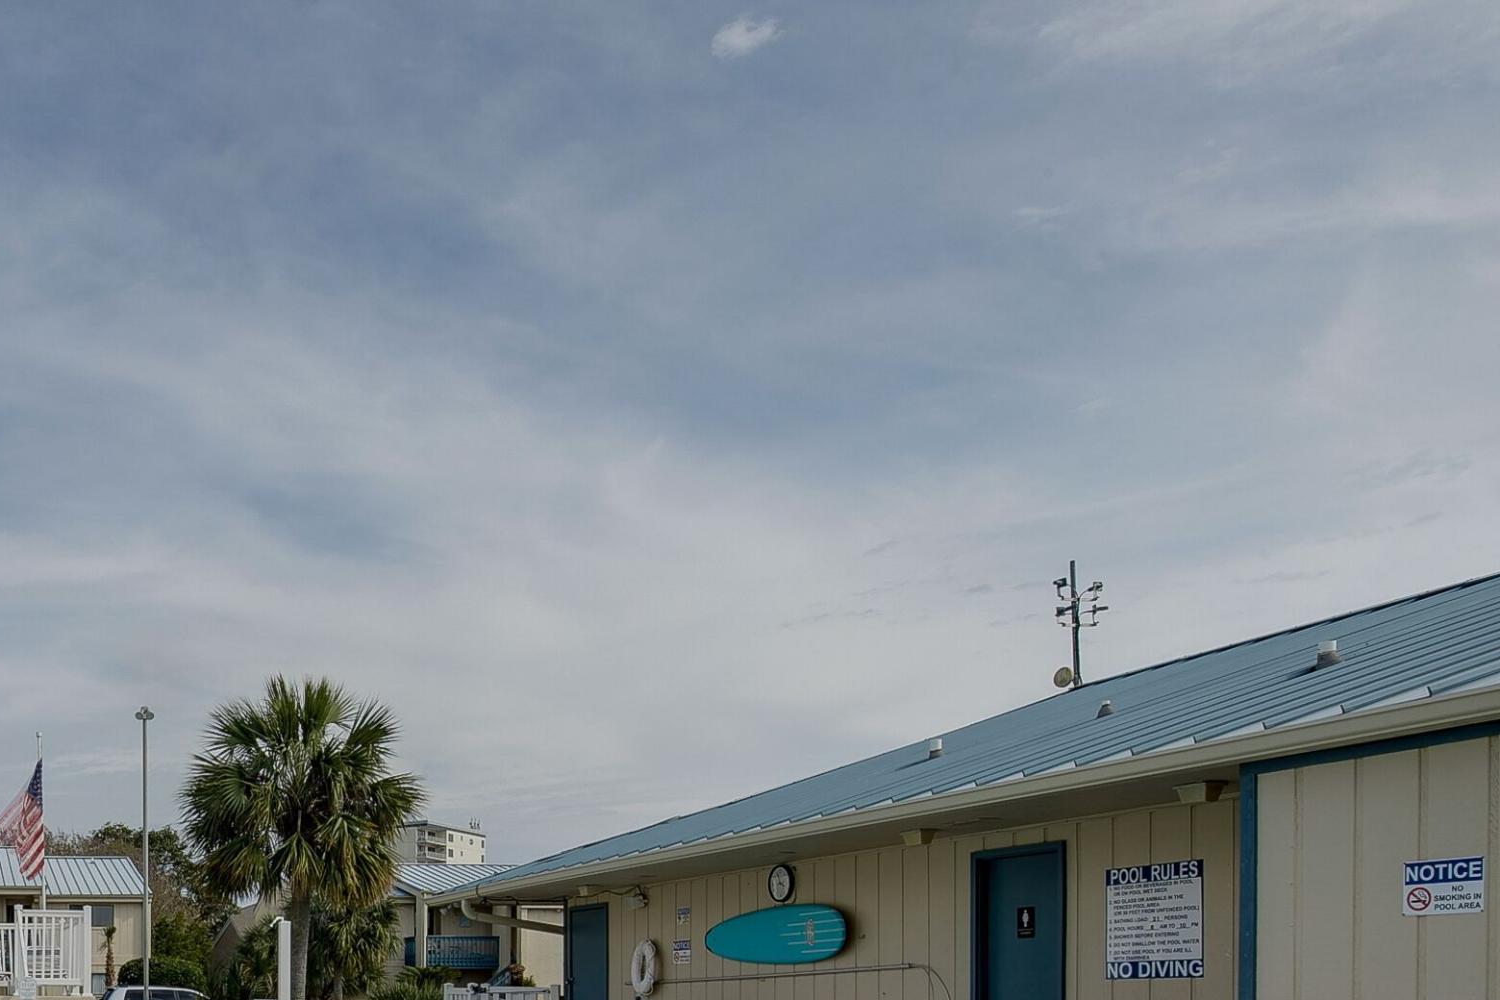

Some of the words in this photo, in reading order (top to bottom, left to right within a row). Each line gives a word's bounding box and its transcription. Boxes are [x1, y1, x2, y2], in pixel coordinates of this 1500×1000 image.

[1110, 867, 1147, 885] POOL
[1151, 860, 1198, 881] RULES
[1405, 860, 1482, 882] NOTICE
[1107, 962, 1133, 978] NO
[1138, 960, 1203, 978] DIVING
